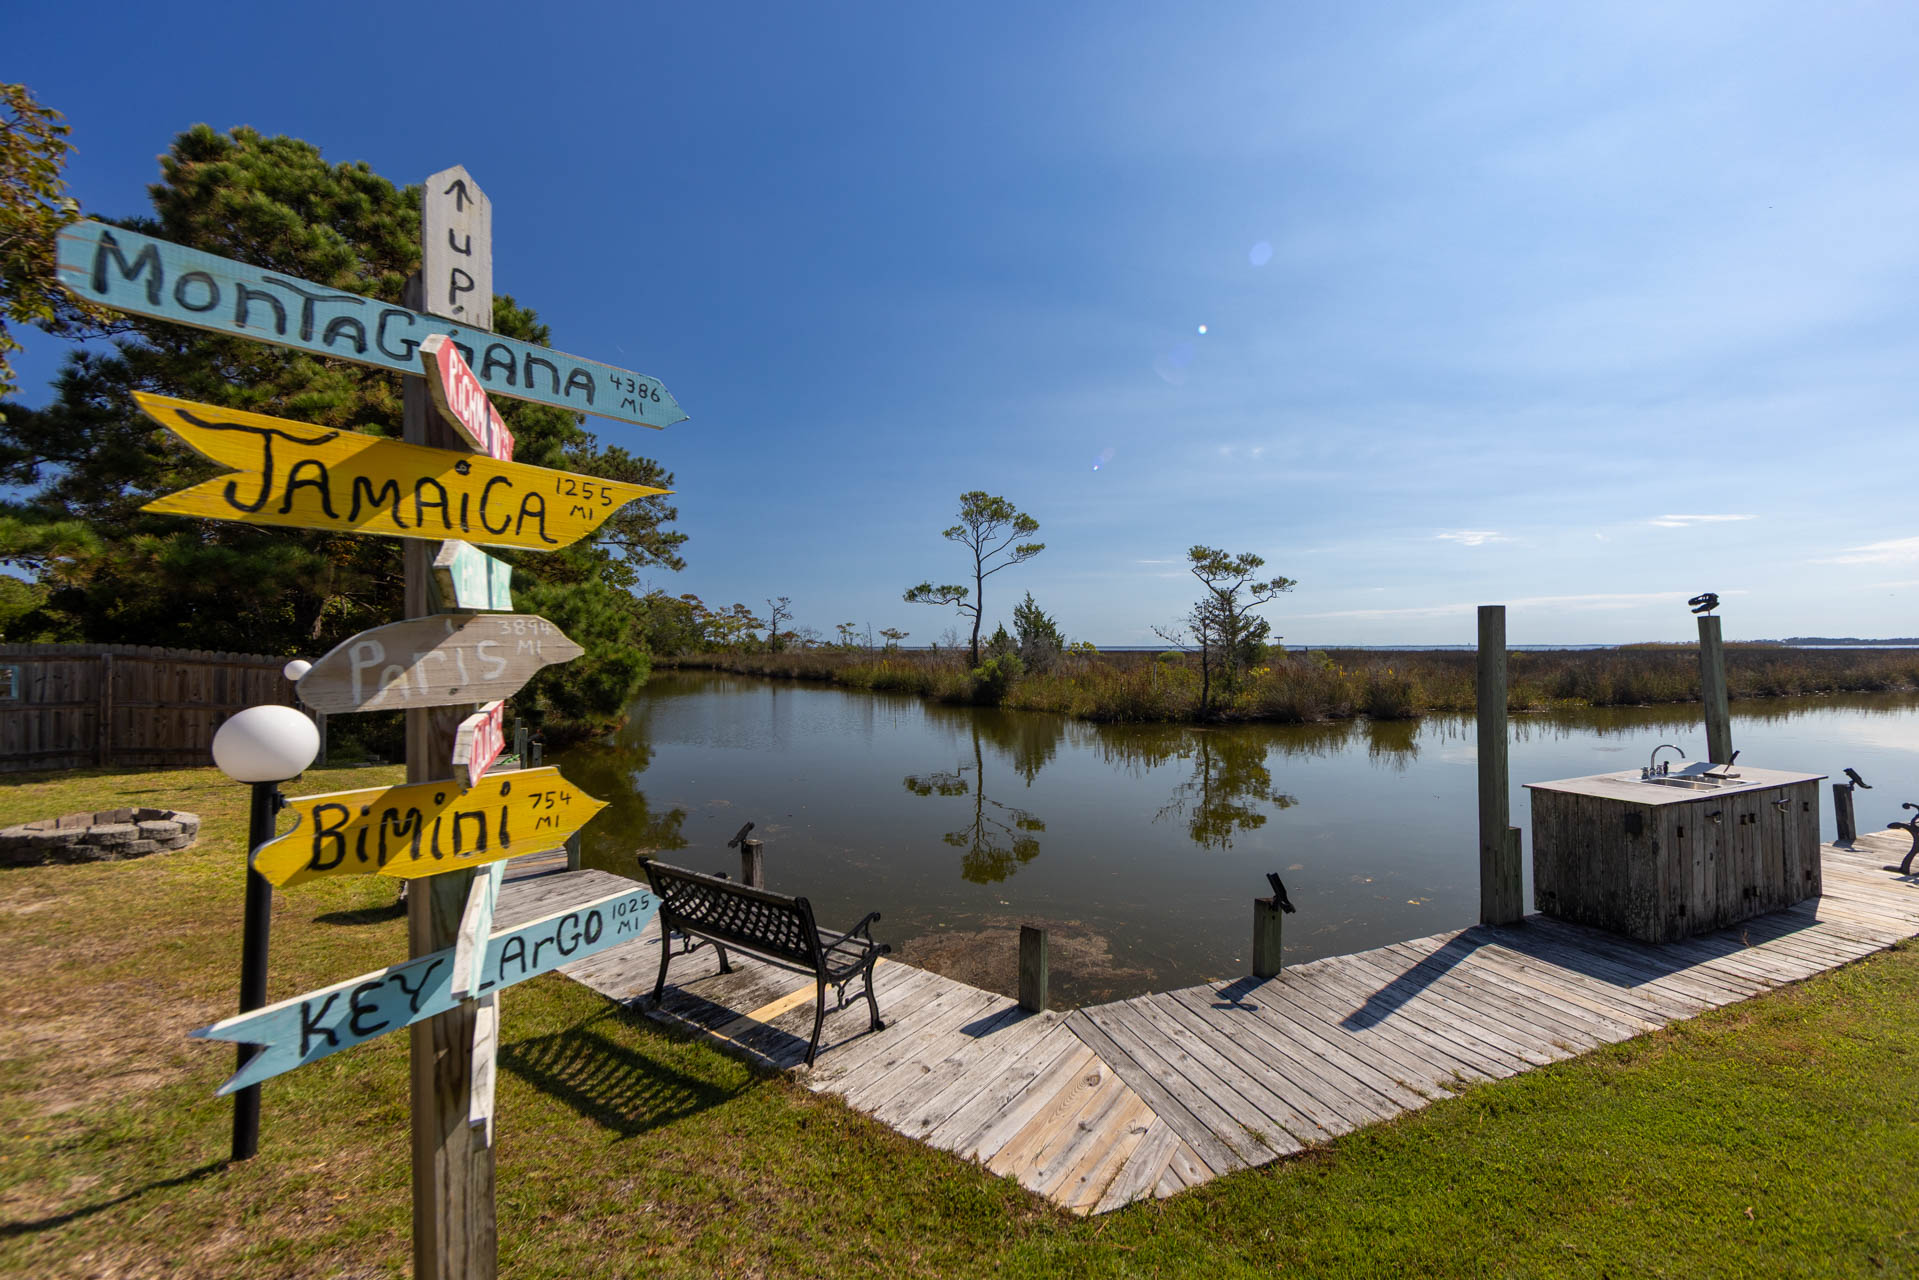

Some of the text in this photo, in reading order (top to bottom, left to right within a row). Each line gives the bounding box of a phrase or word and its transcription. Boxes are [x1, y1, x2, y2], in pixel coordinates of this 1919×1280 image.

[609, 373, 661, 403] 4386
[620, 397, 644, 416] MI
[556, 477, 613, 507] 1255
[569, 505, 593, 521] MI
[497, 619, 552, 636] 3894
[517, 639, 541, 656] MI
[527, 790, 573, 810] 754
[535, 814, 560, 830] MI
[612, 893, 650, 920] 1025
[617, 916, 640, 935] MI
[298, 957, 446, 1059] KEY
